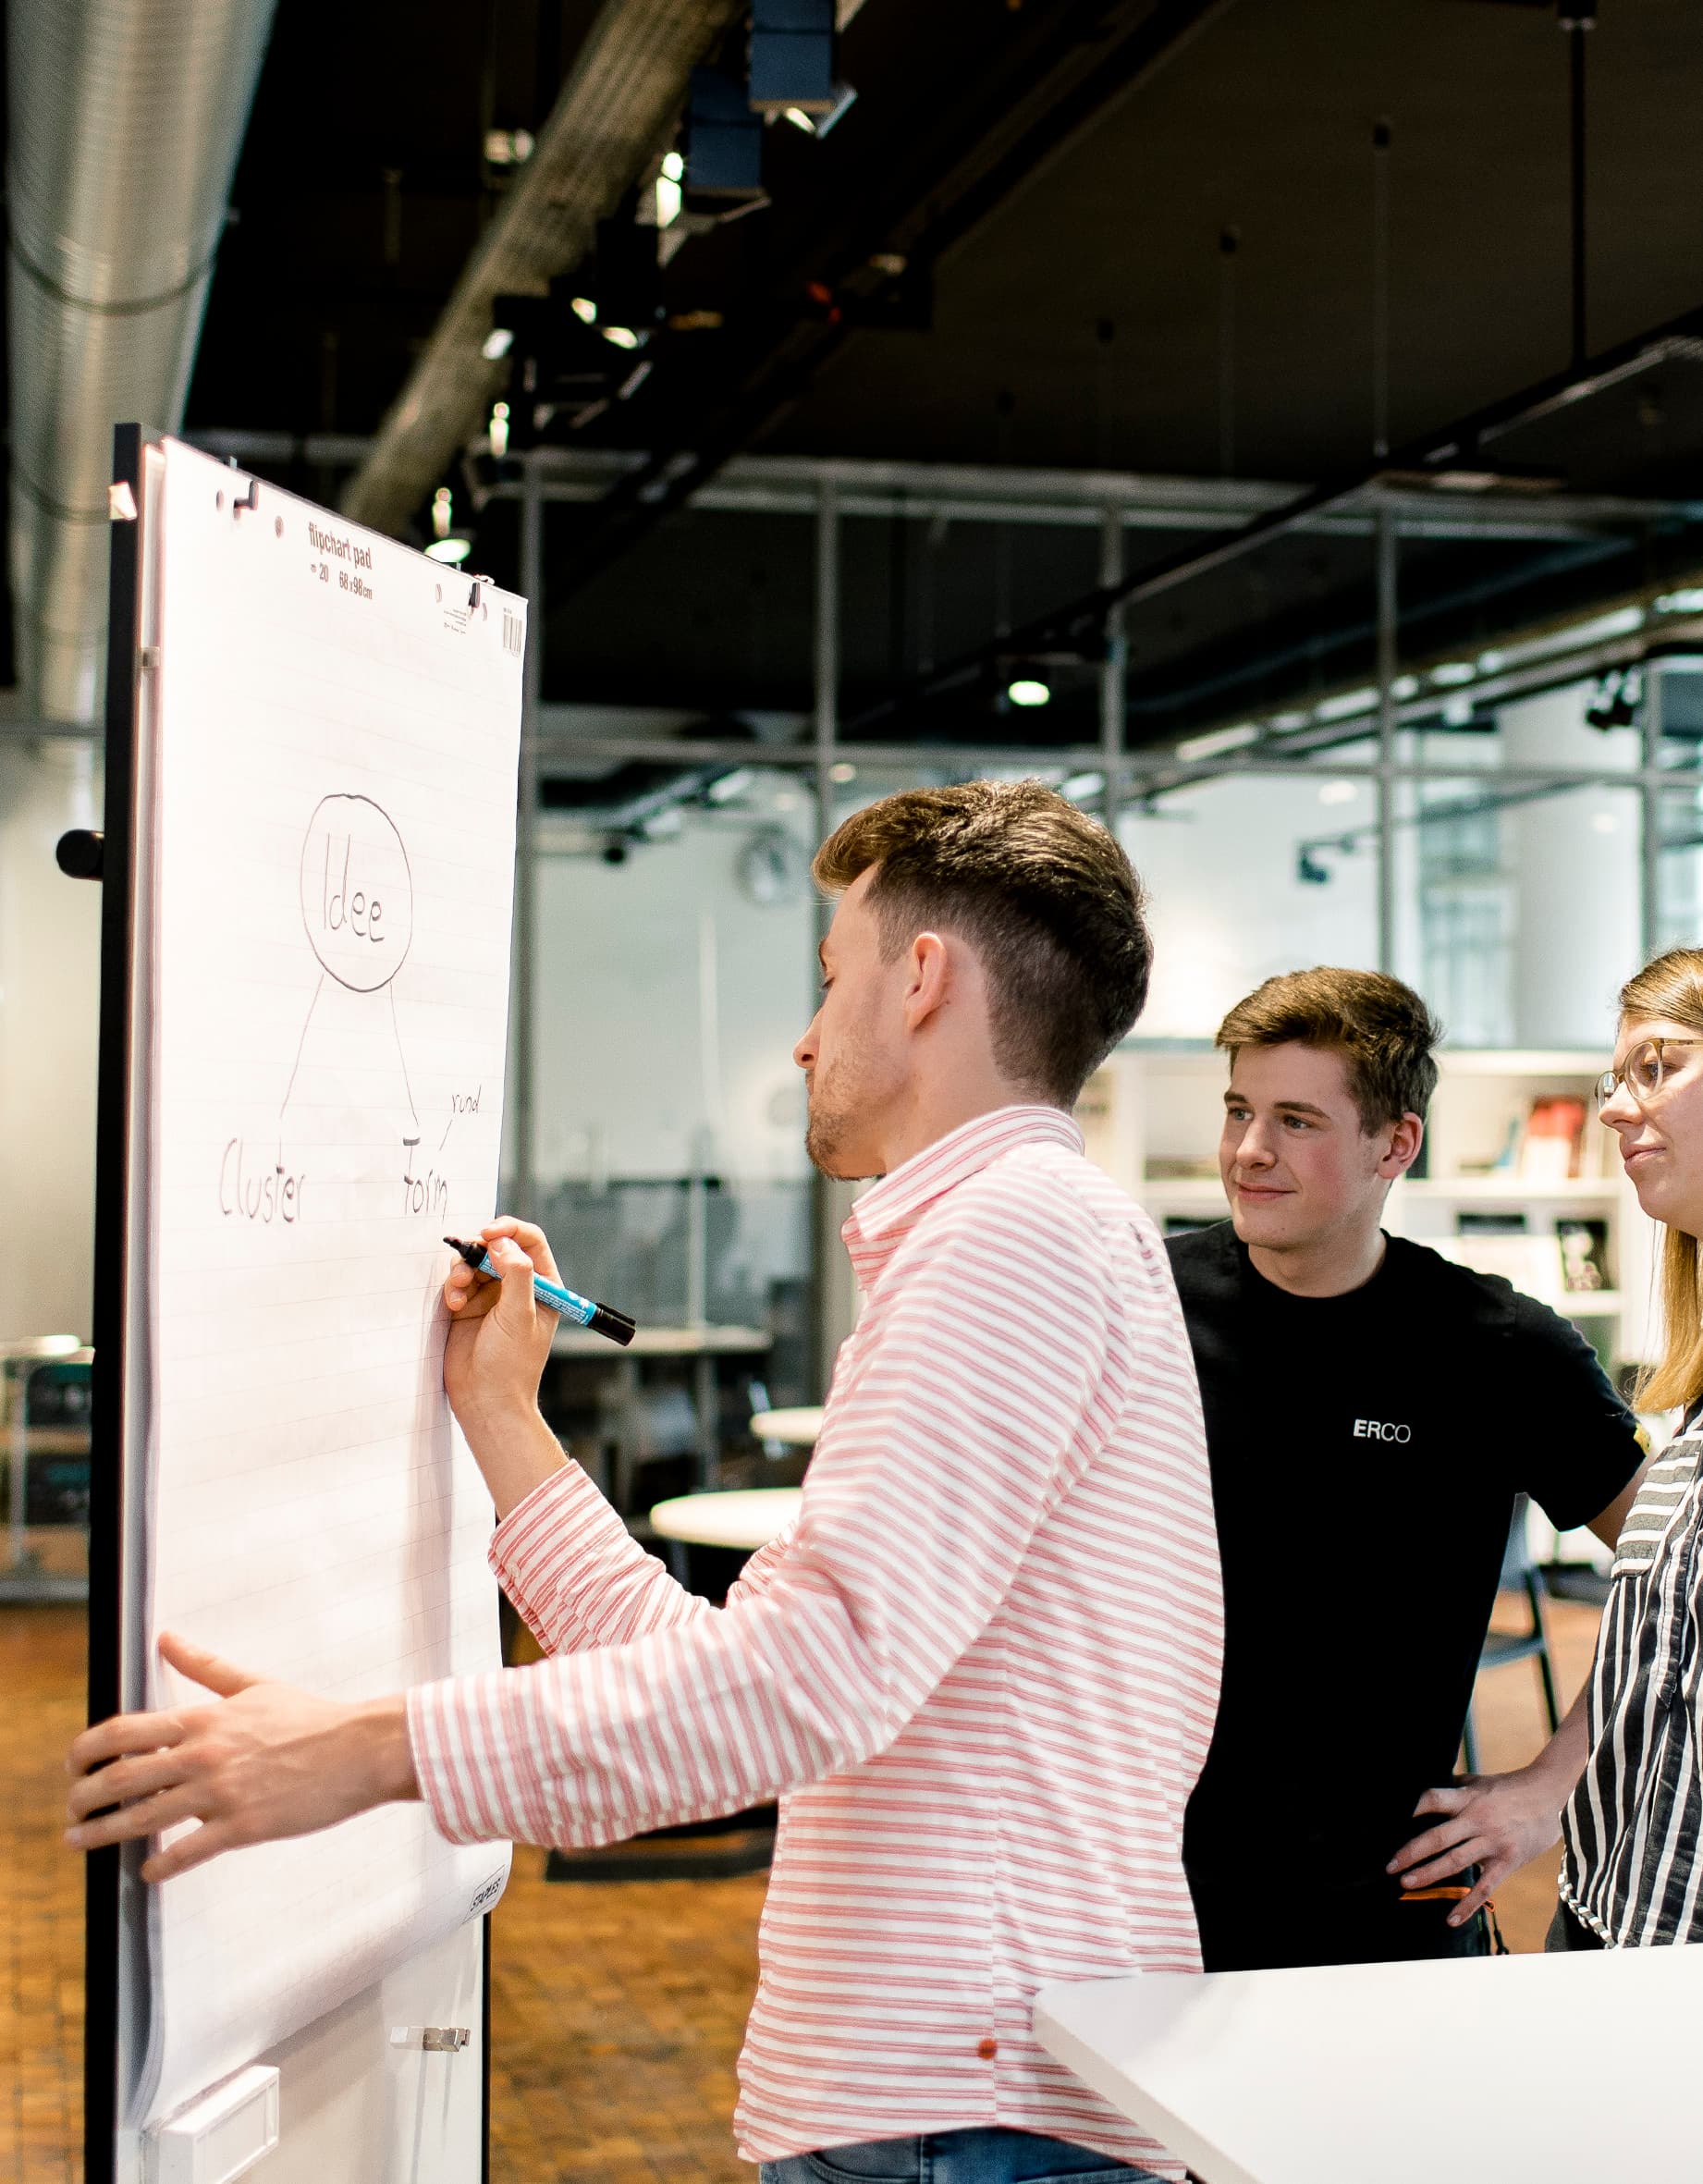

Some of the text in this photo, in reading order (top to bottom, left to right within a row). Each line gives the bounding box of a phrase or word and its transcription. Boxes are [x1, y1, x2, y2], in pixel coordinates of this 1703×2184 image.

[309, 521, 373, 571] flipchart pad
[319, 562, 329, 583] 20
[324, 832, 385, 942] Idee
[220, 1135, 305, 1223] Cluster
[1353, 1418, 1411, 1443] ERCO
[470, 1877, 501, 1912] STAPLES
